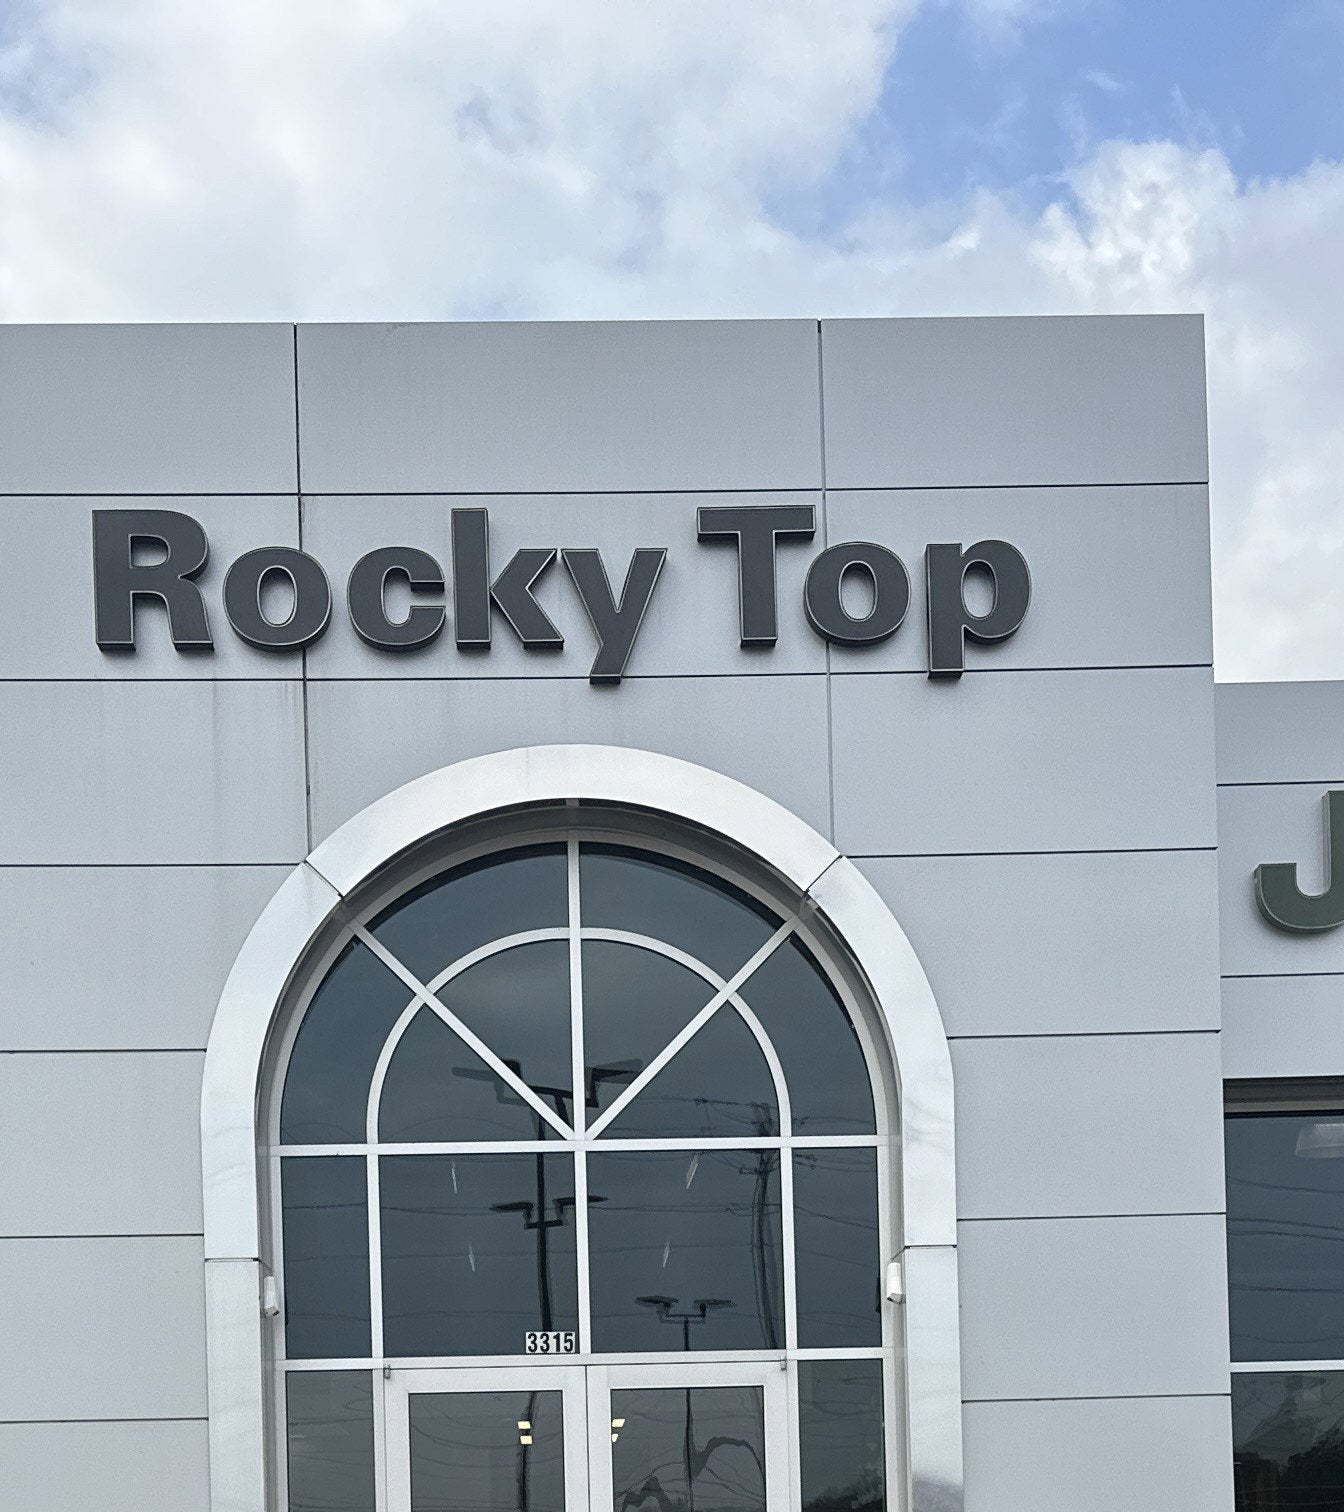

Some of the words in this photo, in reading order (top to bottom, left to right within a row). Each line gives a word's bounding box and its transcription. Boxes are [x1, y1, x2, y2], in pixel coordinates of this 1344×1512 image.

[92, 508, 668, 684] Rocky
[697, 505, 1032, 679] Top
[527, 1332, 574, 1353] 3315
